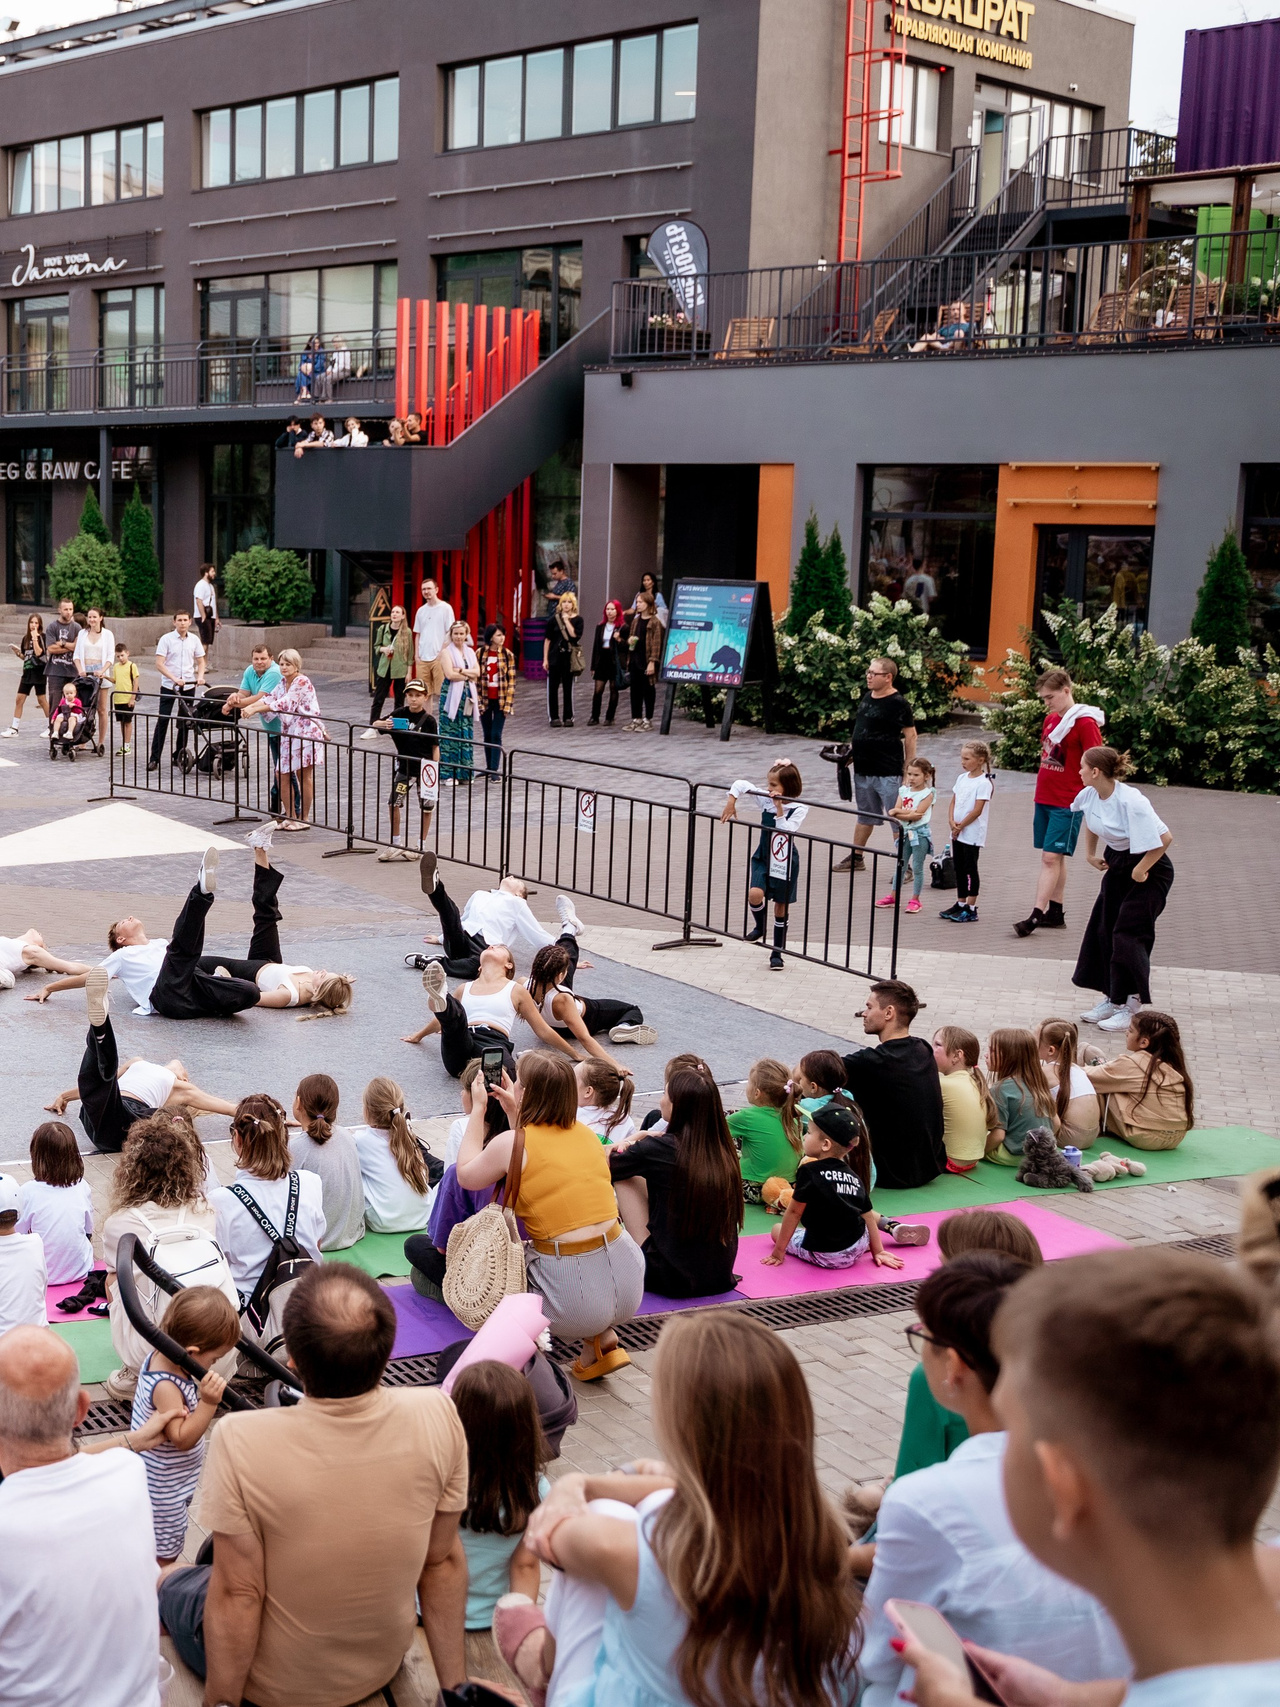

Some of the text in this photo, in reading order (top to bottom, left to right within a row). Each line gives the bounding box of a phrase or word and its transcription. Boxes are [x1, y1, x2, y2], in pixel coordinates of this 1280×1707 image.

[976, 38, 1033, 69] КОМПАНИЯ
[43, 253, 90, 267] HOT YOGA
[24, 462, 37, 480] &
[42, 461, 80, 480] RAW
[84, 460, 132, 480] CFE
